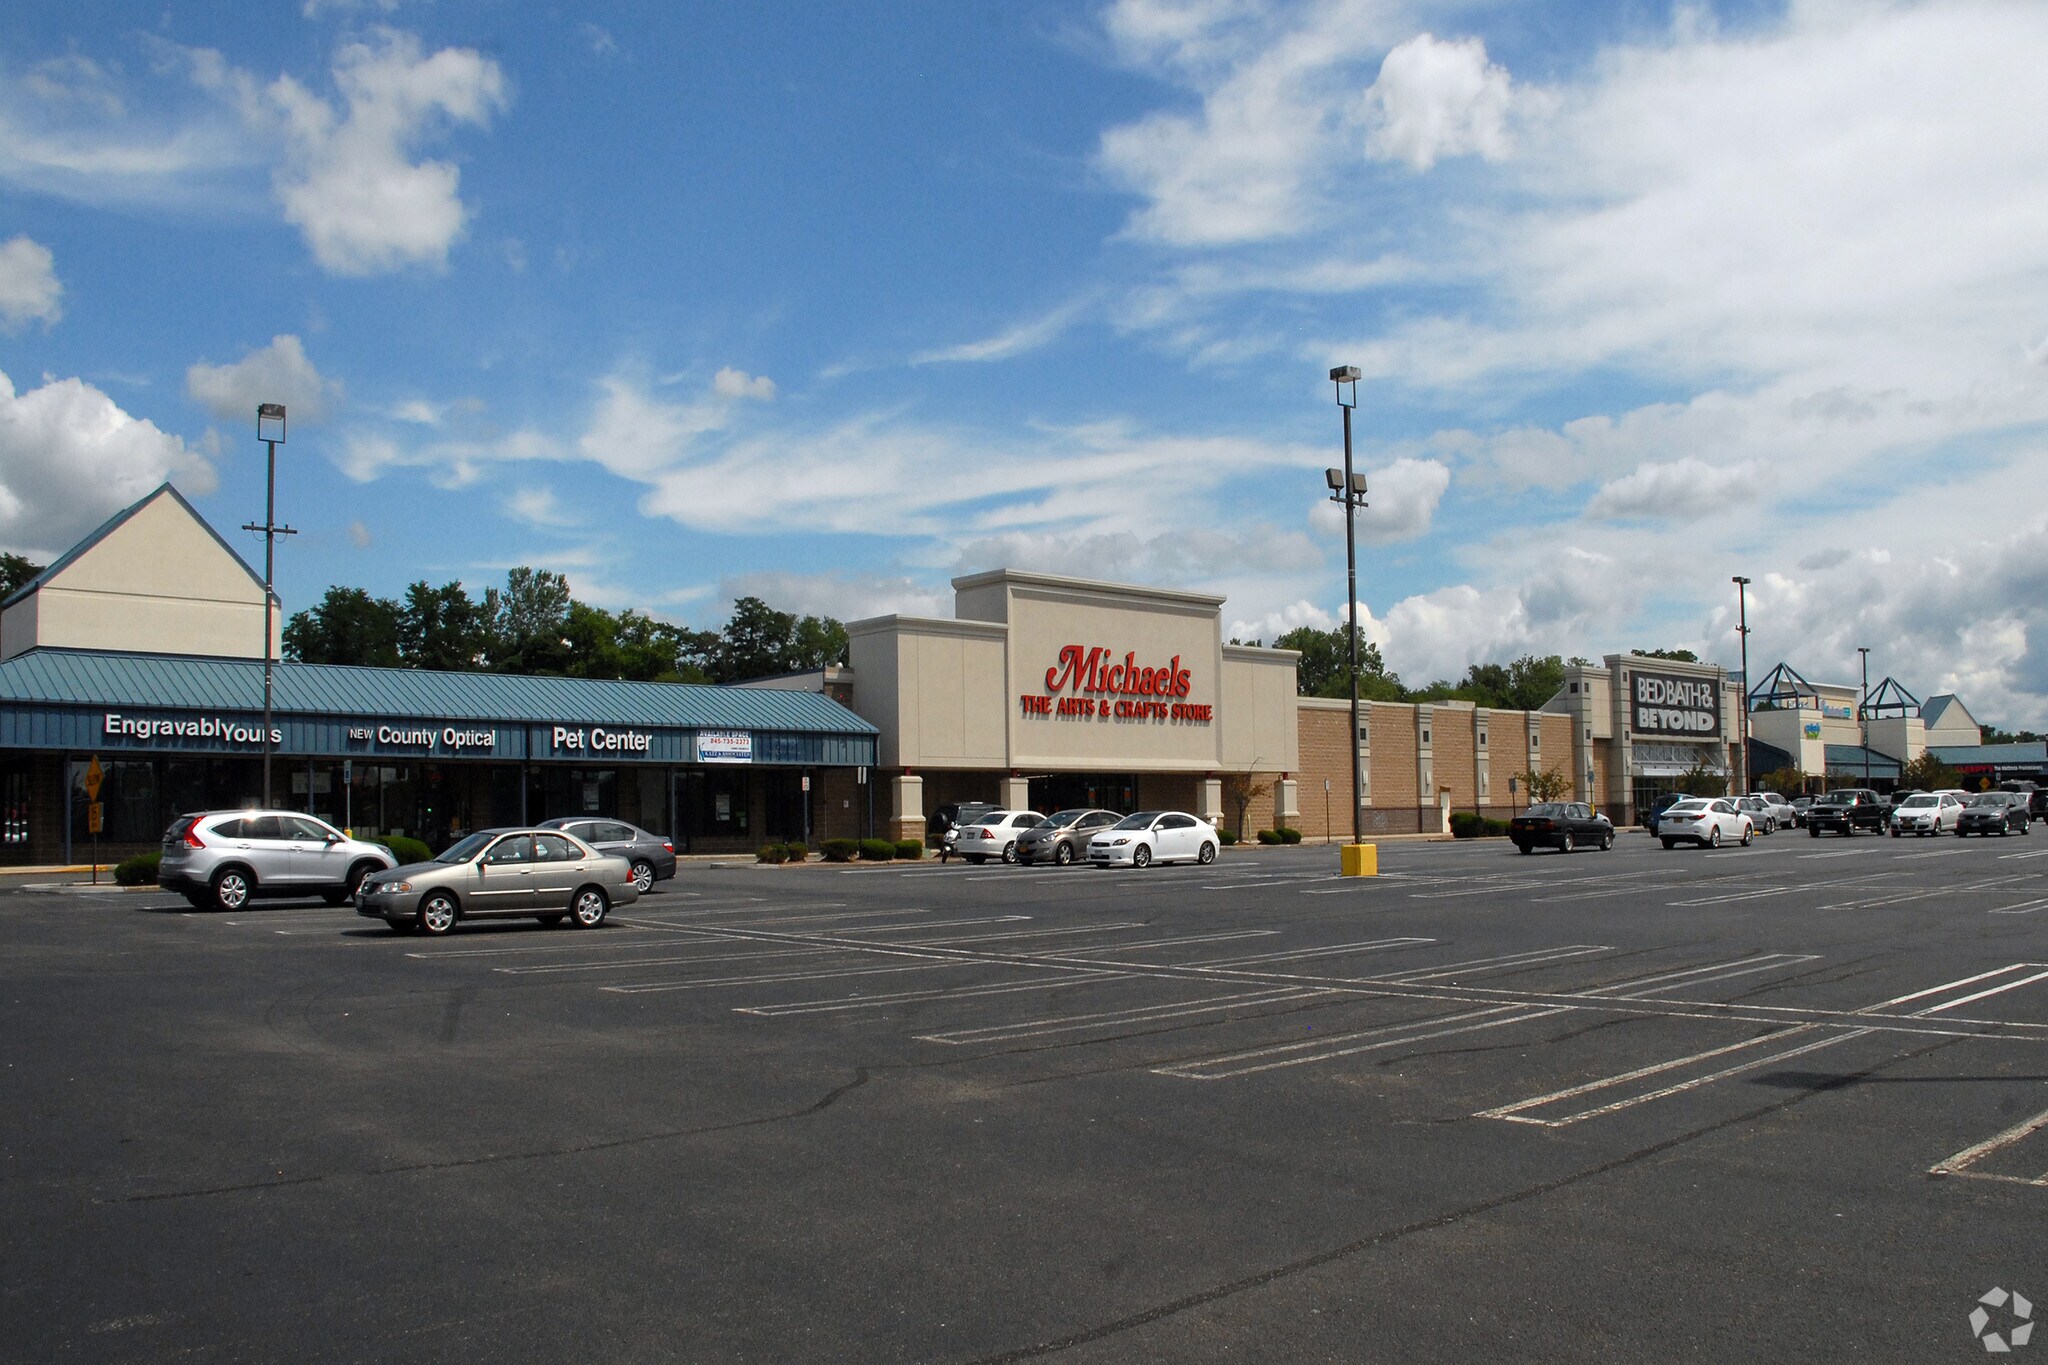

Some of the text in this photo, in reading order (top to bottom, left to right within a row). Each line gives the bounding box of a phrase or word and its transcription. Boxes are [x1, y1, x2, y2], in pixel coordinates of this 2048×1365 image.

[1045, 645, 1191, 697] Michaels
[1638, 677, 1666, 704] BED
[1666, 680, 1701, 706] BATH
[1021, 695, 1213, 720] THE ARTS & CRAFTS STORE
[1638, 707, 1715, 731] BEYOND
[350, 726, 496, 749] NEW County Optical
[554, 726, 653, 750] Pet Center
